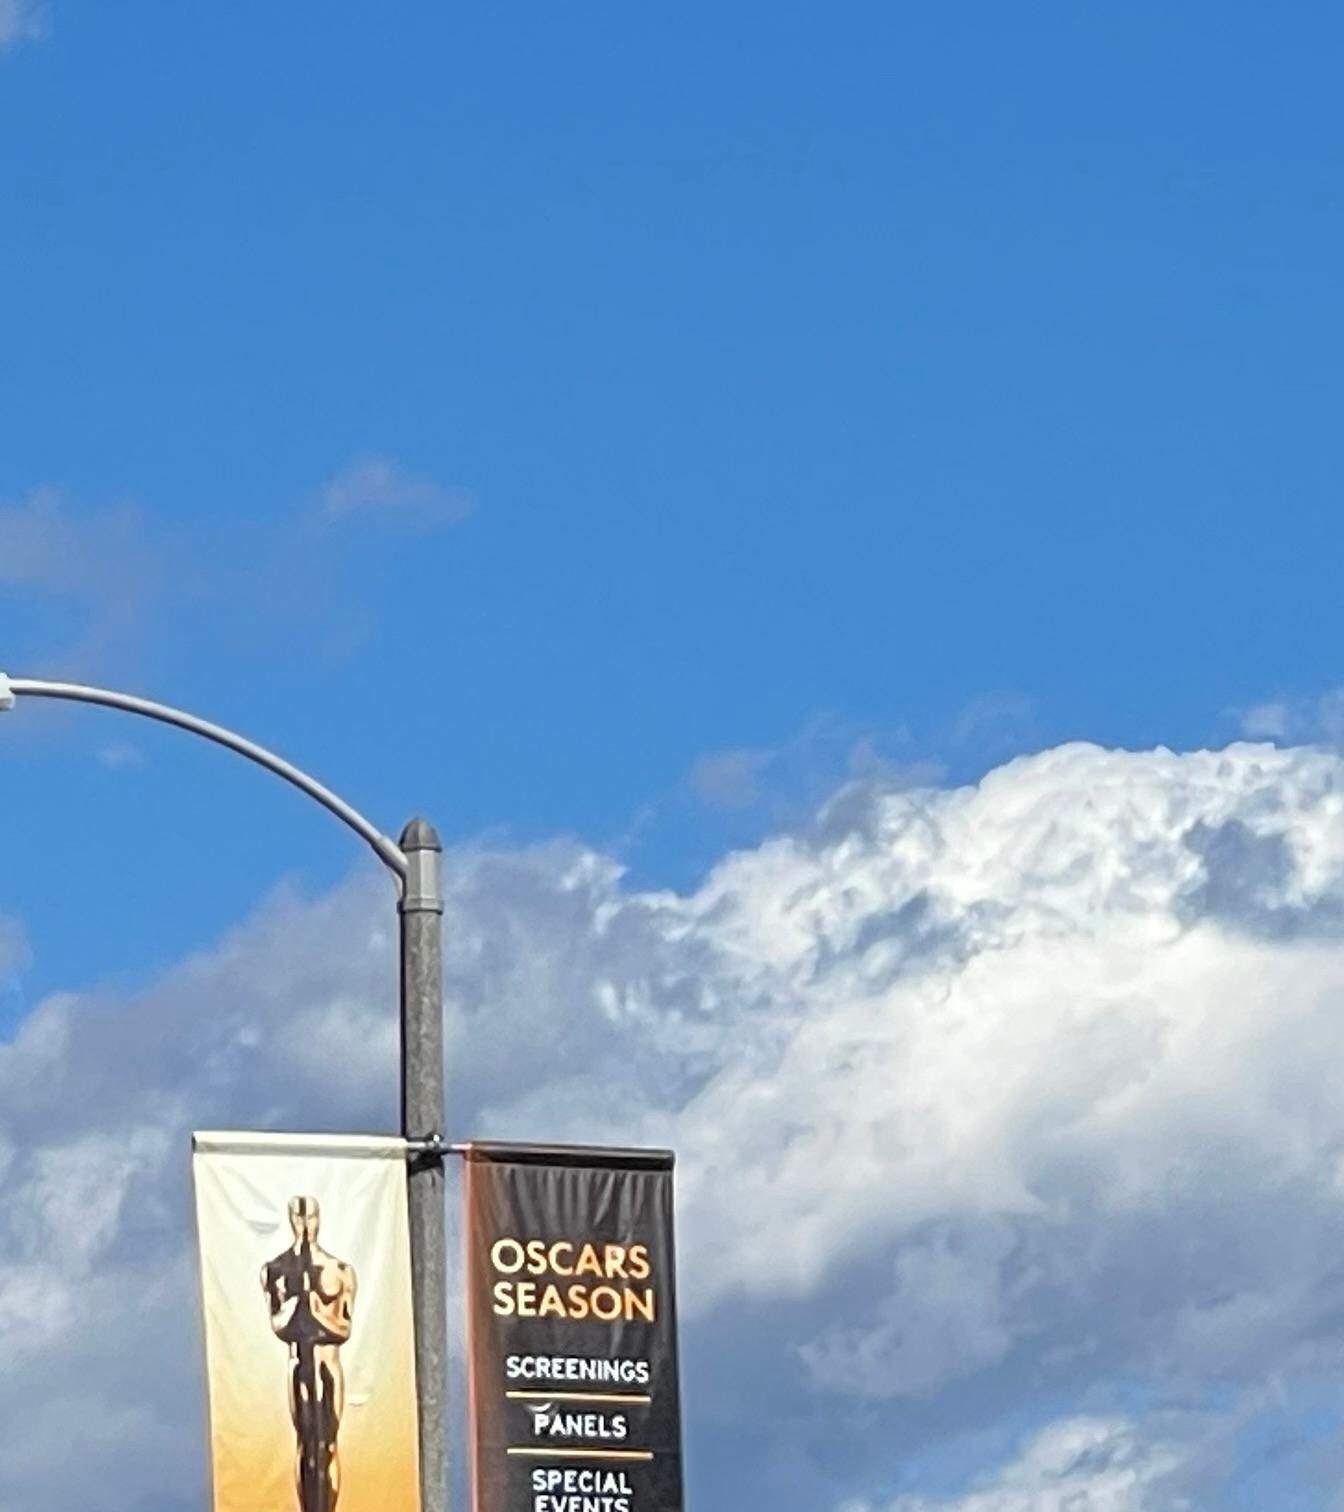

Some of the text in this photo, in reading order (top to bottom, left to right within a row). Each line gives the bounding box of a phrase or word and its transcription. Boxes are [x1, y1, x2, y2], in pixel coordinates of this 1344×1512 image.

[491, 1238, 650, 1279] OSCARS
[493, 1281, 654, 1322] SEASON
[506, 1356, 649, 1383] SCREENINGS
[534, 1412, 627, 1438] PANELS
[532, 1469, 633, 1494] SPECIAL
